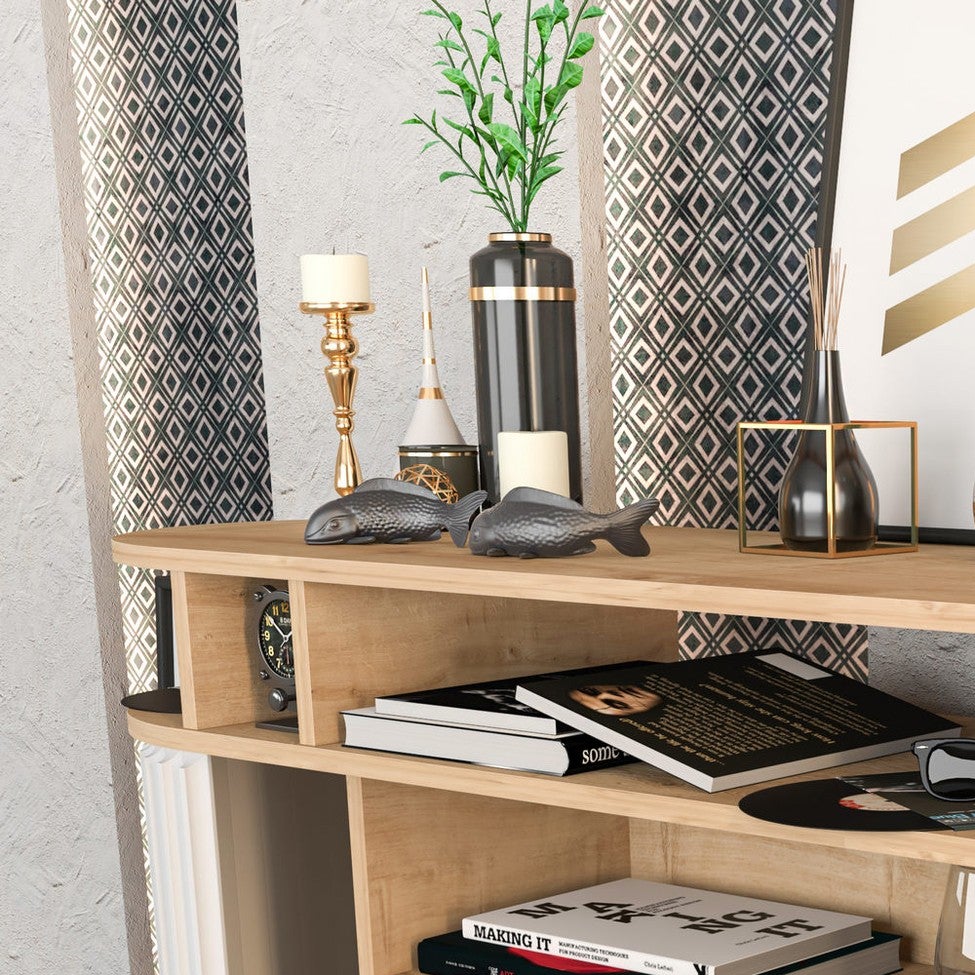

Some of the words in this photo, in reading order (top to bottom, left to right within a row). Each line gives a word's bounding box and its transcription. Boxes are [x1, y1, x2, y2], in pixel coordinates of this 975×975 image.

[582, 746, 620, 764] some
[473, 924, 533, 948] MAKING
[536, 937, 552, 952] IT
